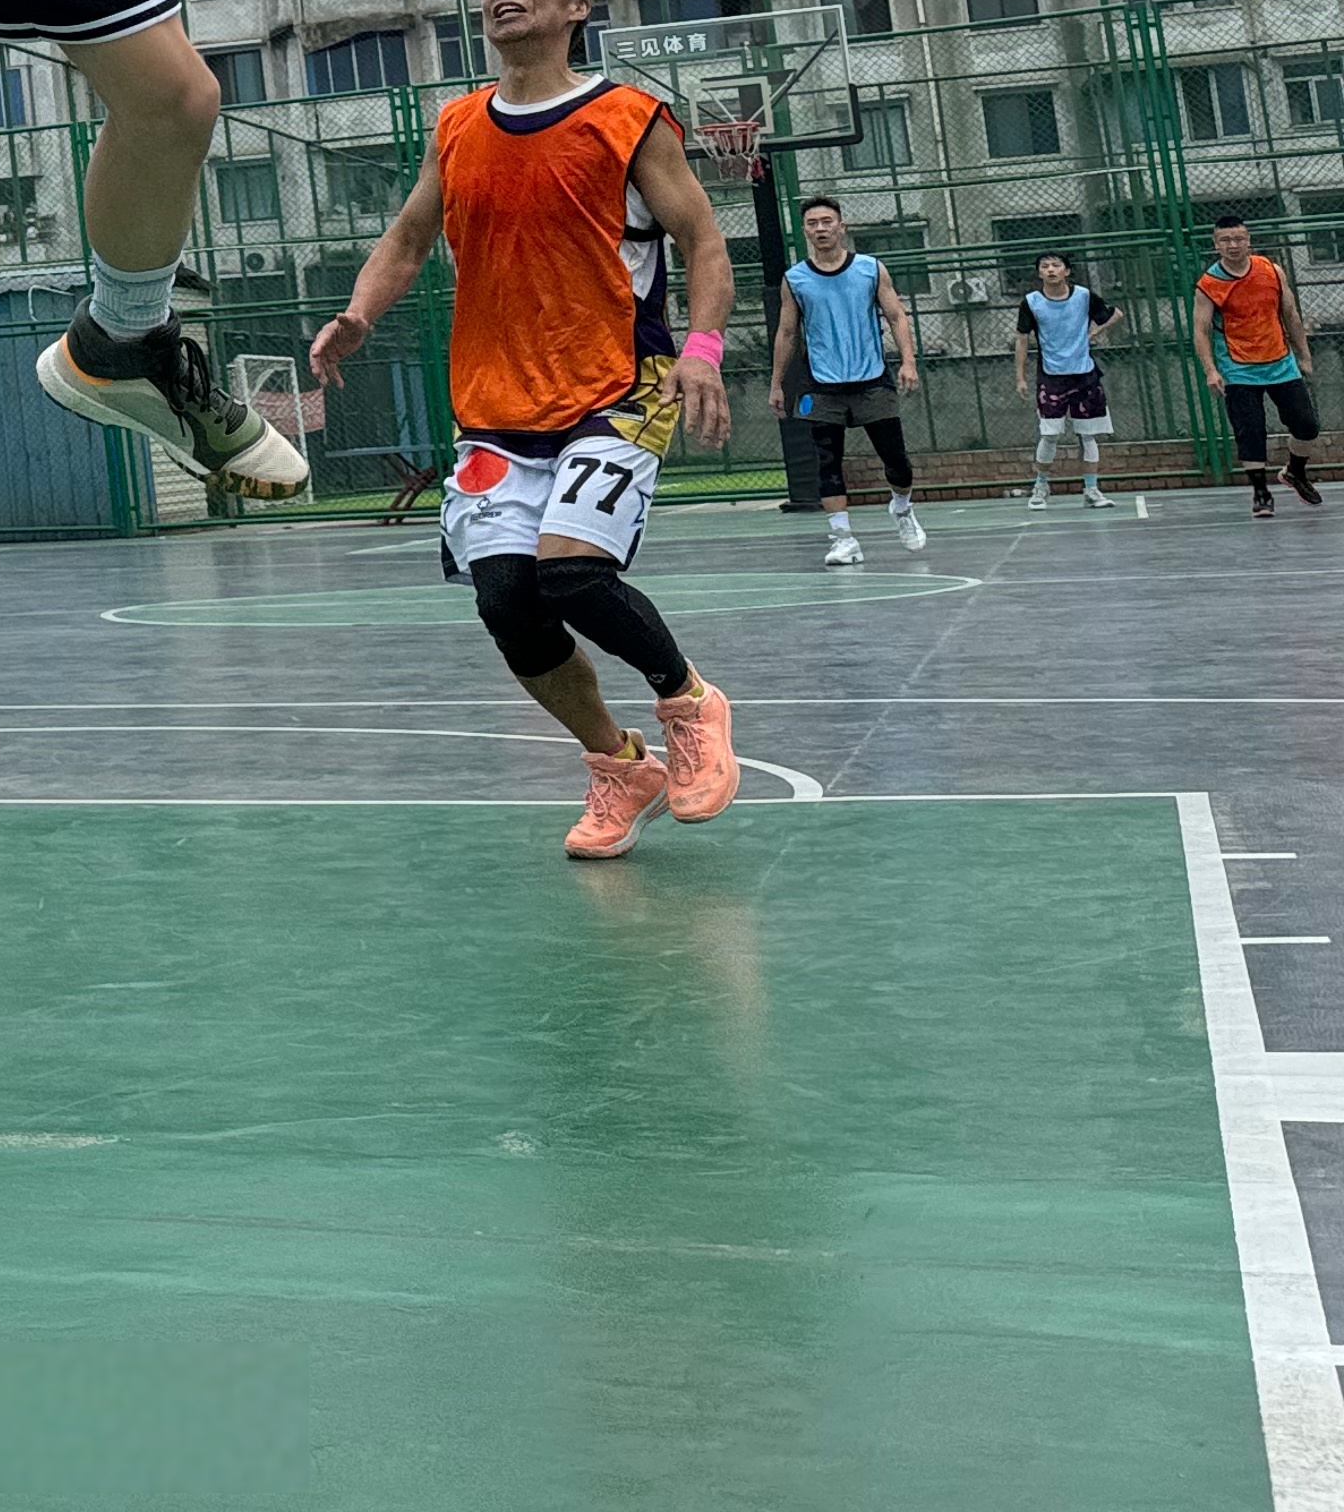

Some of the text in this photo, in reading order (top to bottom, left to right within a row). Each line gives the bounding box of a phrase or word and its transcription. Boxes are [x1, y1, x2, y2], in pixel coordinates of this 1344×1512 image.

[616, 32, 708, 61] 三见体育
[559, 457, 634, 517] 77
